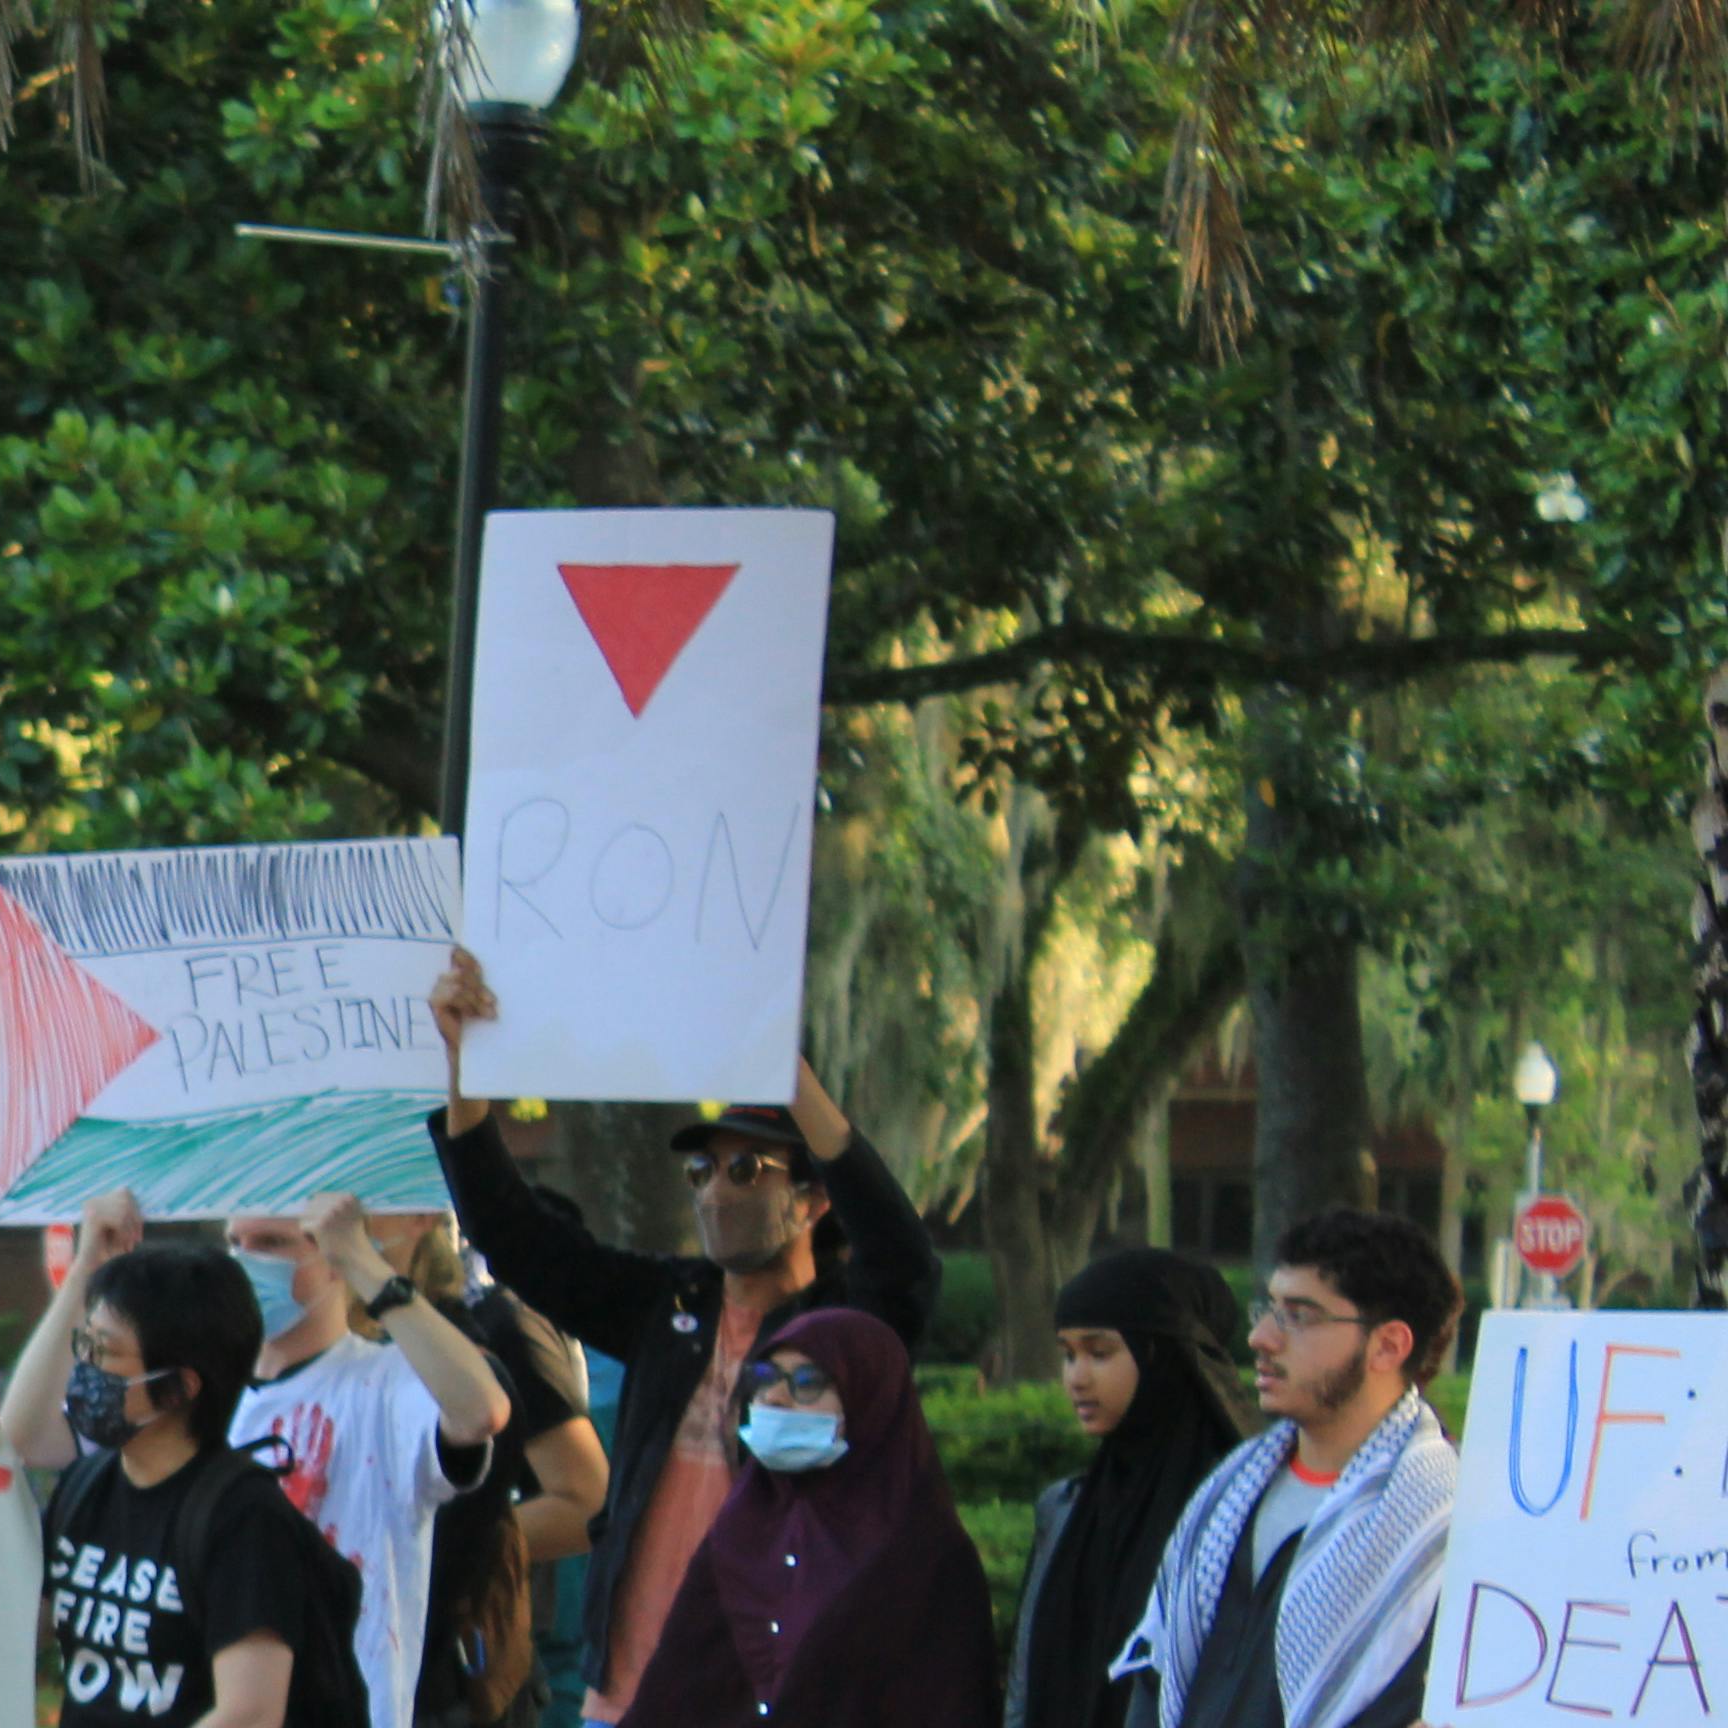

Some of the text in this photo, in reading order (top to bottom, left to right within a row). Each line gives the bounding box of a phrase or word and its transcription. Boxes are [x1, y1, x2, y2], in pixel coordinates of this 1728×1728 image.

[492, 795, 801, 952] RON
[184, 943, 351, 1008] FREE
[166, 997, 440, 1094] PALESTINE
[1519, 1215, 1584, 1253] STOP
[52, 1588, 152, 1655] FIRE
[1455, 1580, 1728, 1718] DEA
[66, 1645, 186, 1717] OW
